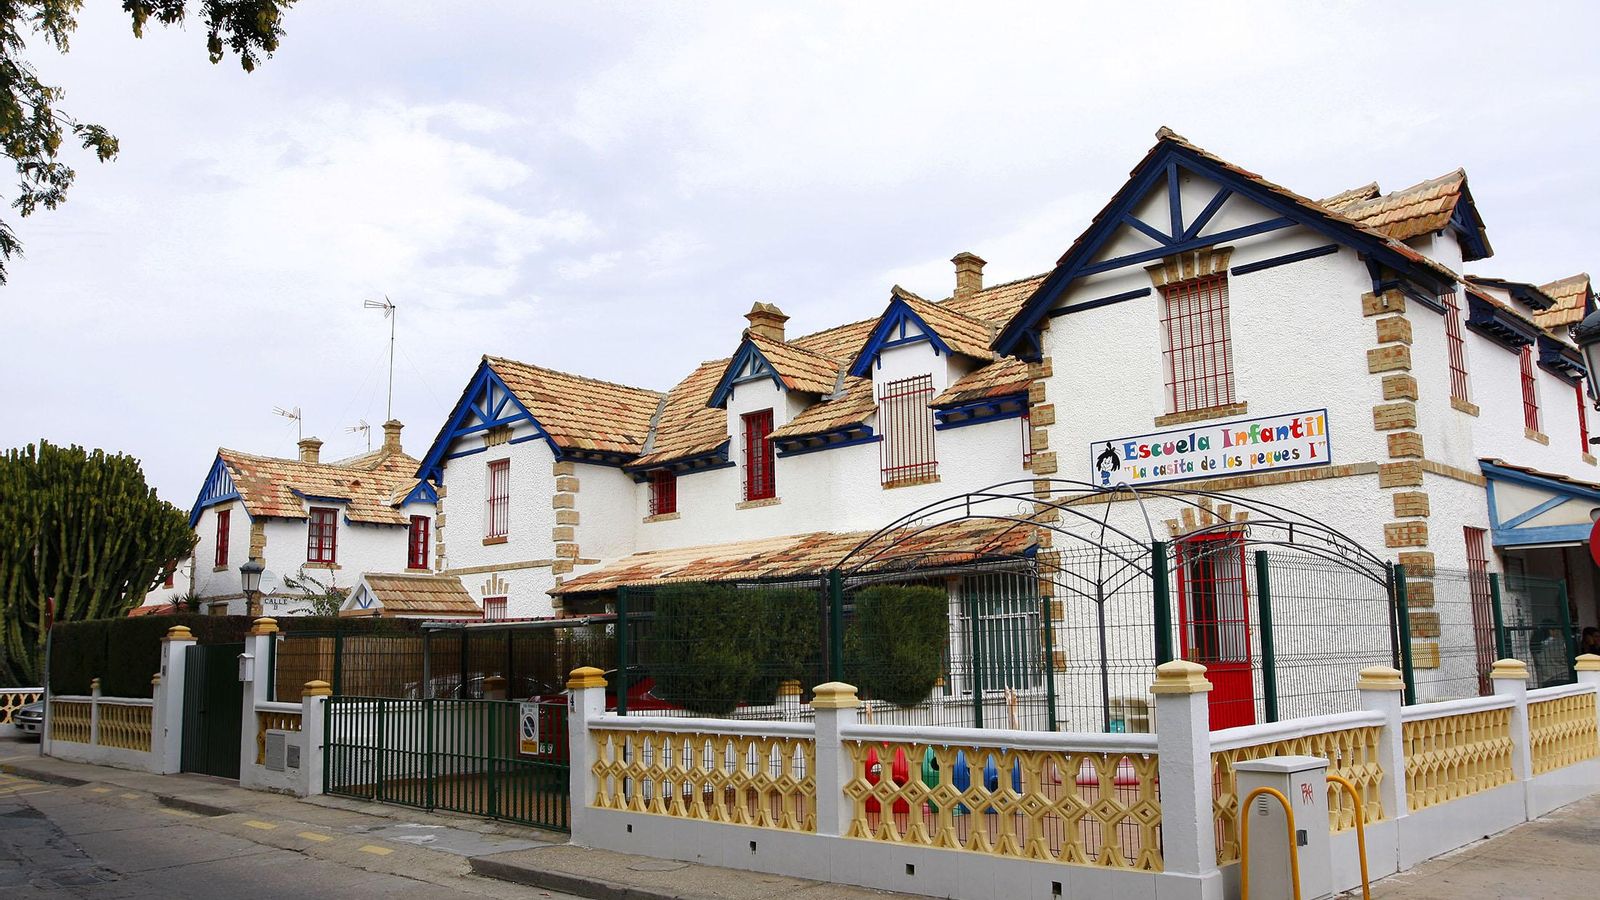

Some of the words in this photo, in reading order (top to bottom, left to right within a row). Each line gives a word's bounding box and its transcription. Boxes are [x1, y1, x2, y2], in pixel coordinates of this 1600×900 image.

[1122, 432, 1210, 461] Escuela
[1221, 414, 1324, 449] Infantil
[1153, 458, 1194, 477] casita
[1201, 455, 1216, 471] de
[1222, 453, 1242, 469] los
[1249, 448, 1300, 469] peques
